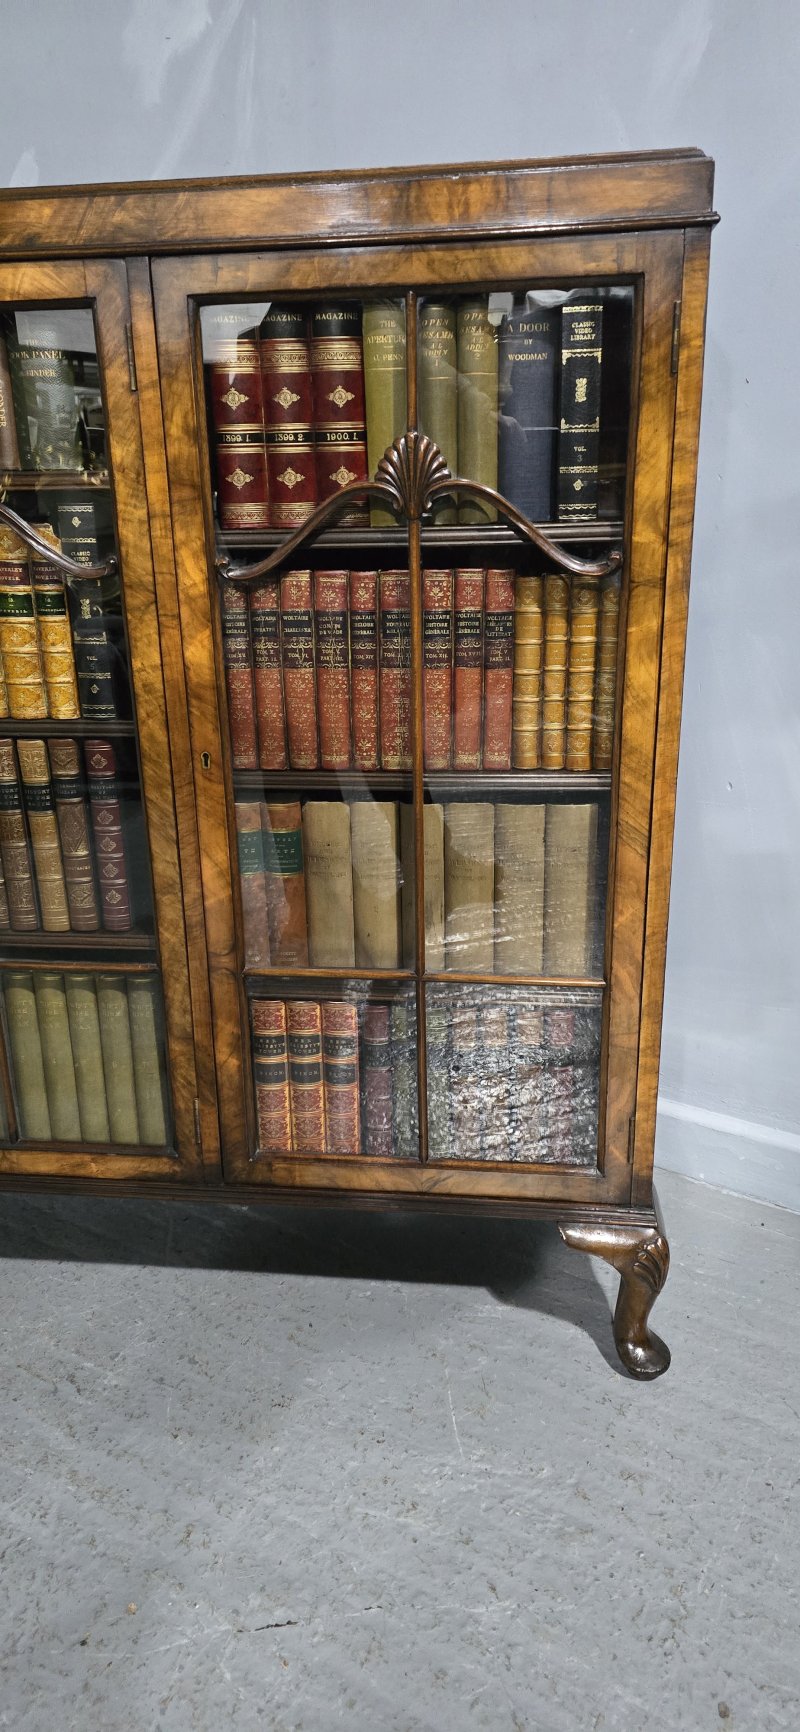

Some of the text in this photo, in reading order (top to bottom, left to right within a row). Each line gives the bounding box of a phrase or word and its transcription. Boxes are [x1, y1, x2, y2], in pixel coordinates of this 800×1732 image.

[315, 312, 359, 320] MAGAZINE
[380, 320, 396, 328] THE
[519, 322, 550, 332] DOOR
[32, 350, 66, 360] PANEL
[508, 353, 548, 361] WOODMAN
